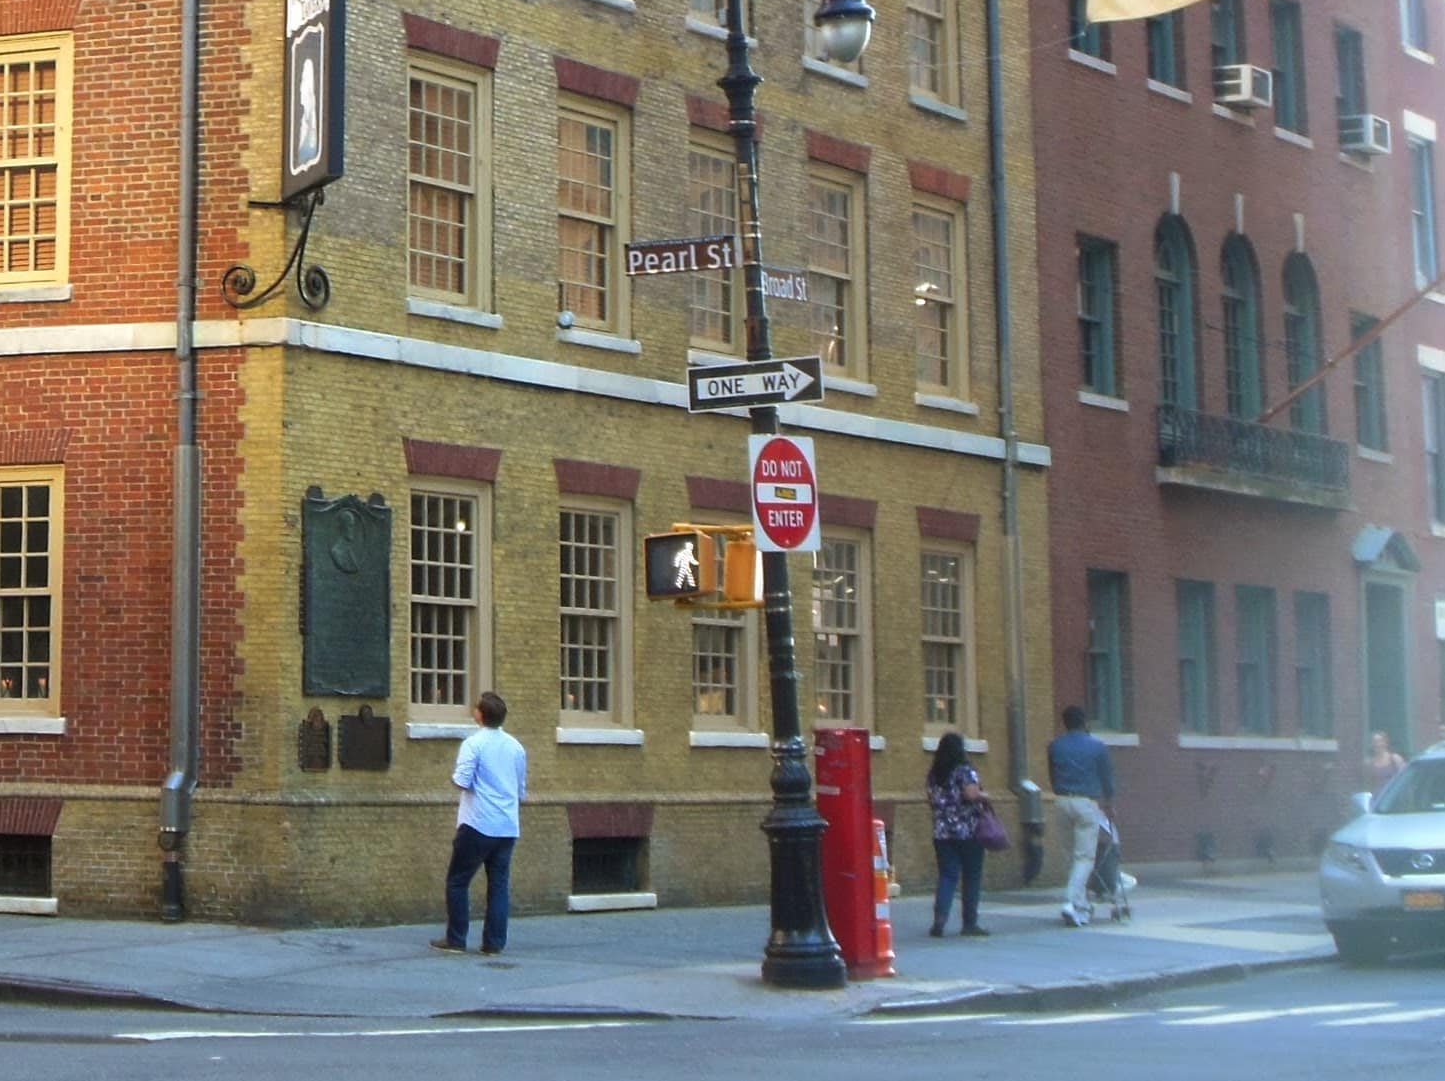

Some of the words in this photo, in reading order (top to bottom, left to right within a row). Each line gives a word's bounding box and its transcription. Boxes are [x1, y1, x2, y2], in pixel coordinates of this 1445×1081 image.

[628, 244, 699, 275] Pearl
[707, 242, 733, 269] St
[762, 271, 794, 300] Broad
[795, 275, 808, 301] St
[708, 378, 745, 396] ONE
[762, 373, 800, 391] WAY
[761, 460, 777, 476] DO
[781, 460, 803, 478] NOT
[768, 510, 804, 527] ENTER
